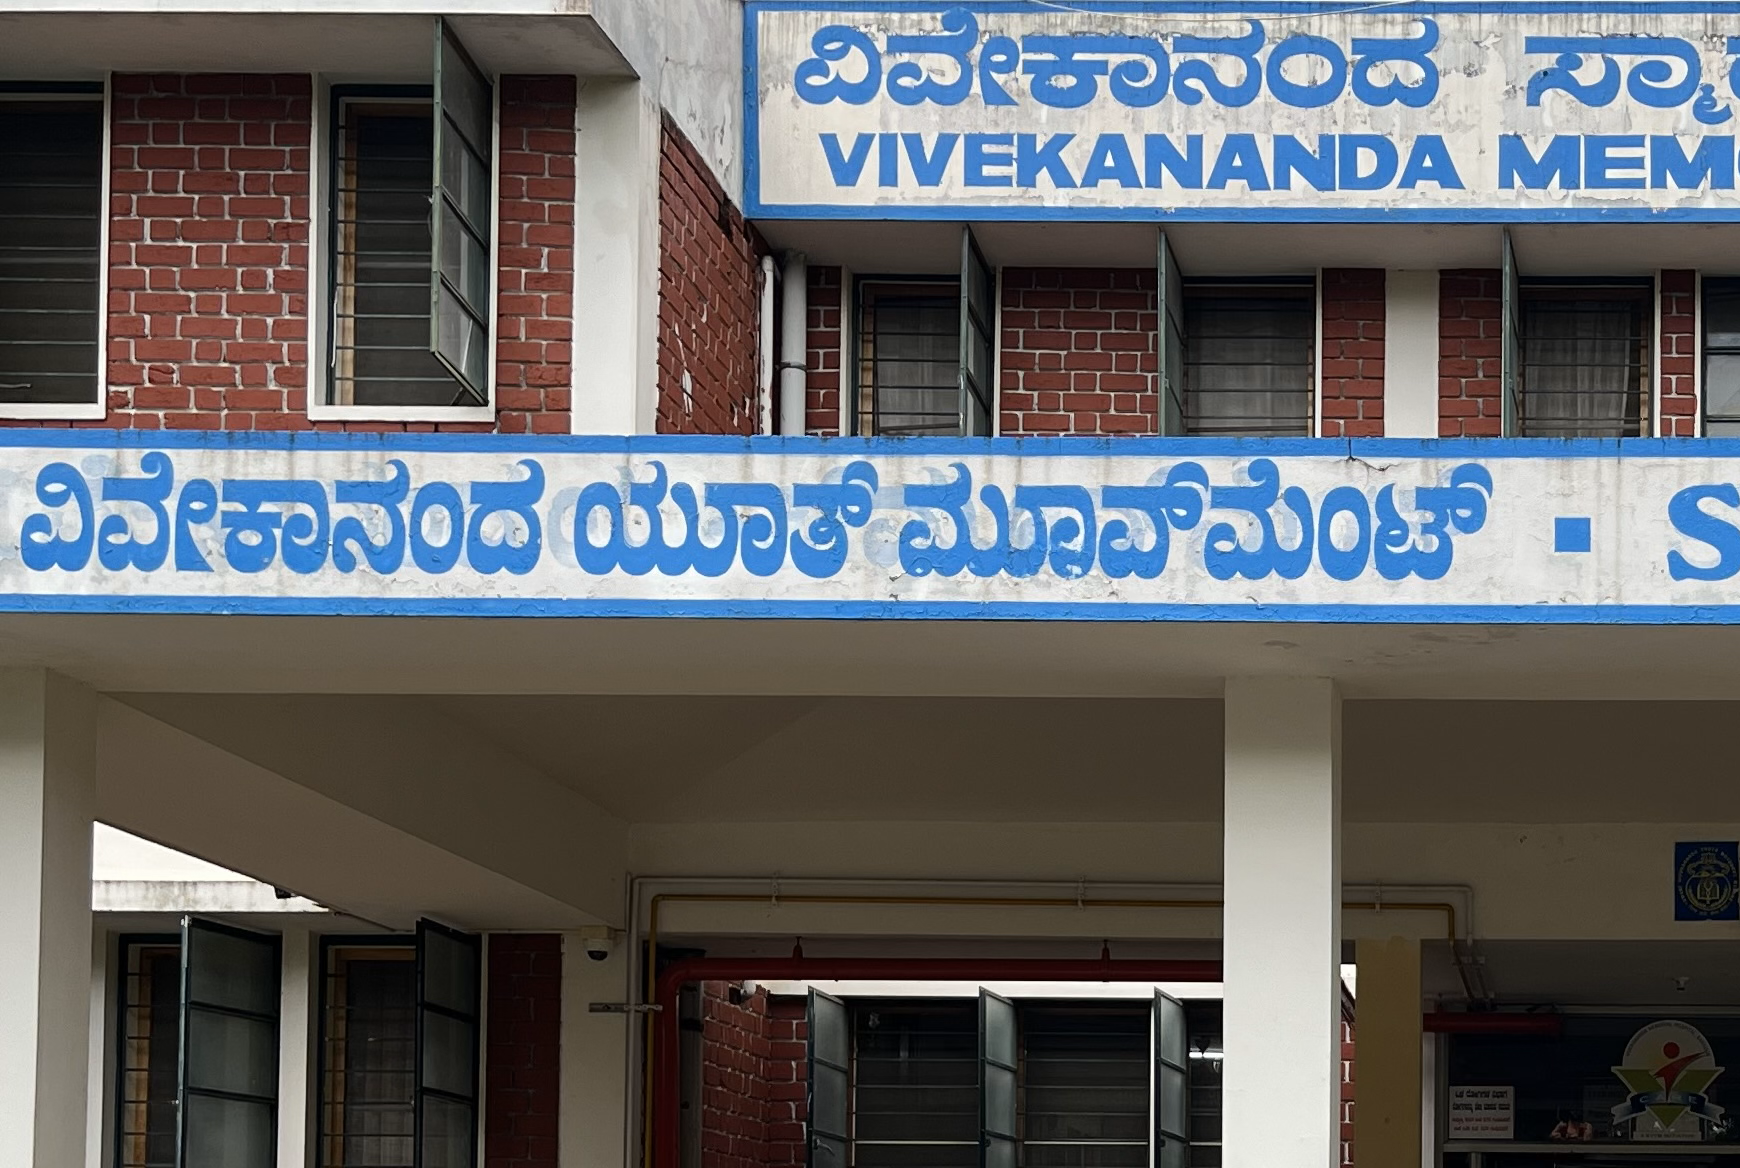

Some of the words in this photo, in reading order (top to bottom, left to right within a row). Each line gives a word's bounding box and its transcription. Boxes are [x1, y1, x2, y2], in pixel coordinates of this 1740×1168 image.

[793, 8, 1439, 108] ವಿವೇಕಾನಂದ
[819, 133, 1464, 191] VIVEKANANDA
[20, 451, 545, 575] ವಿವೇಕಾನಂದ
